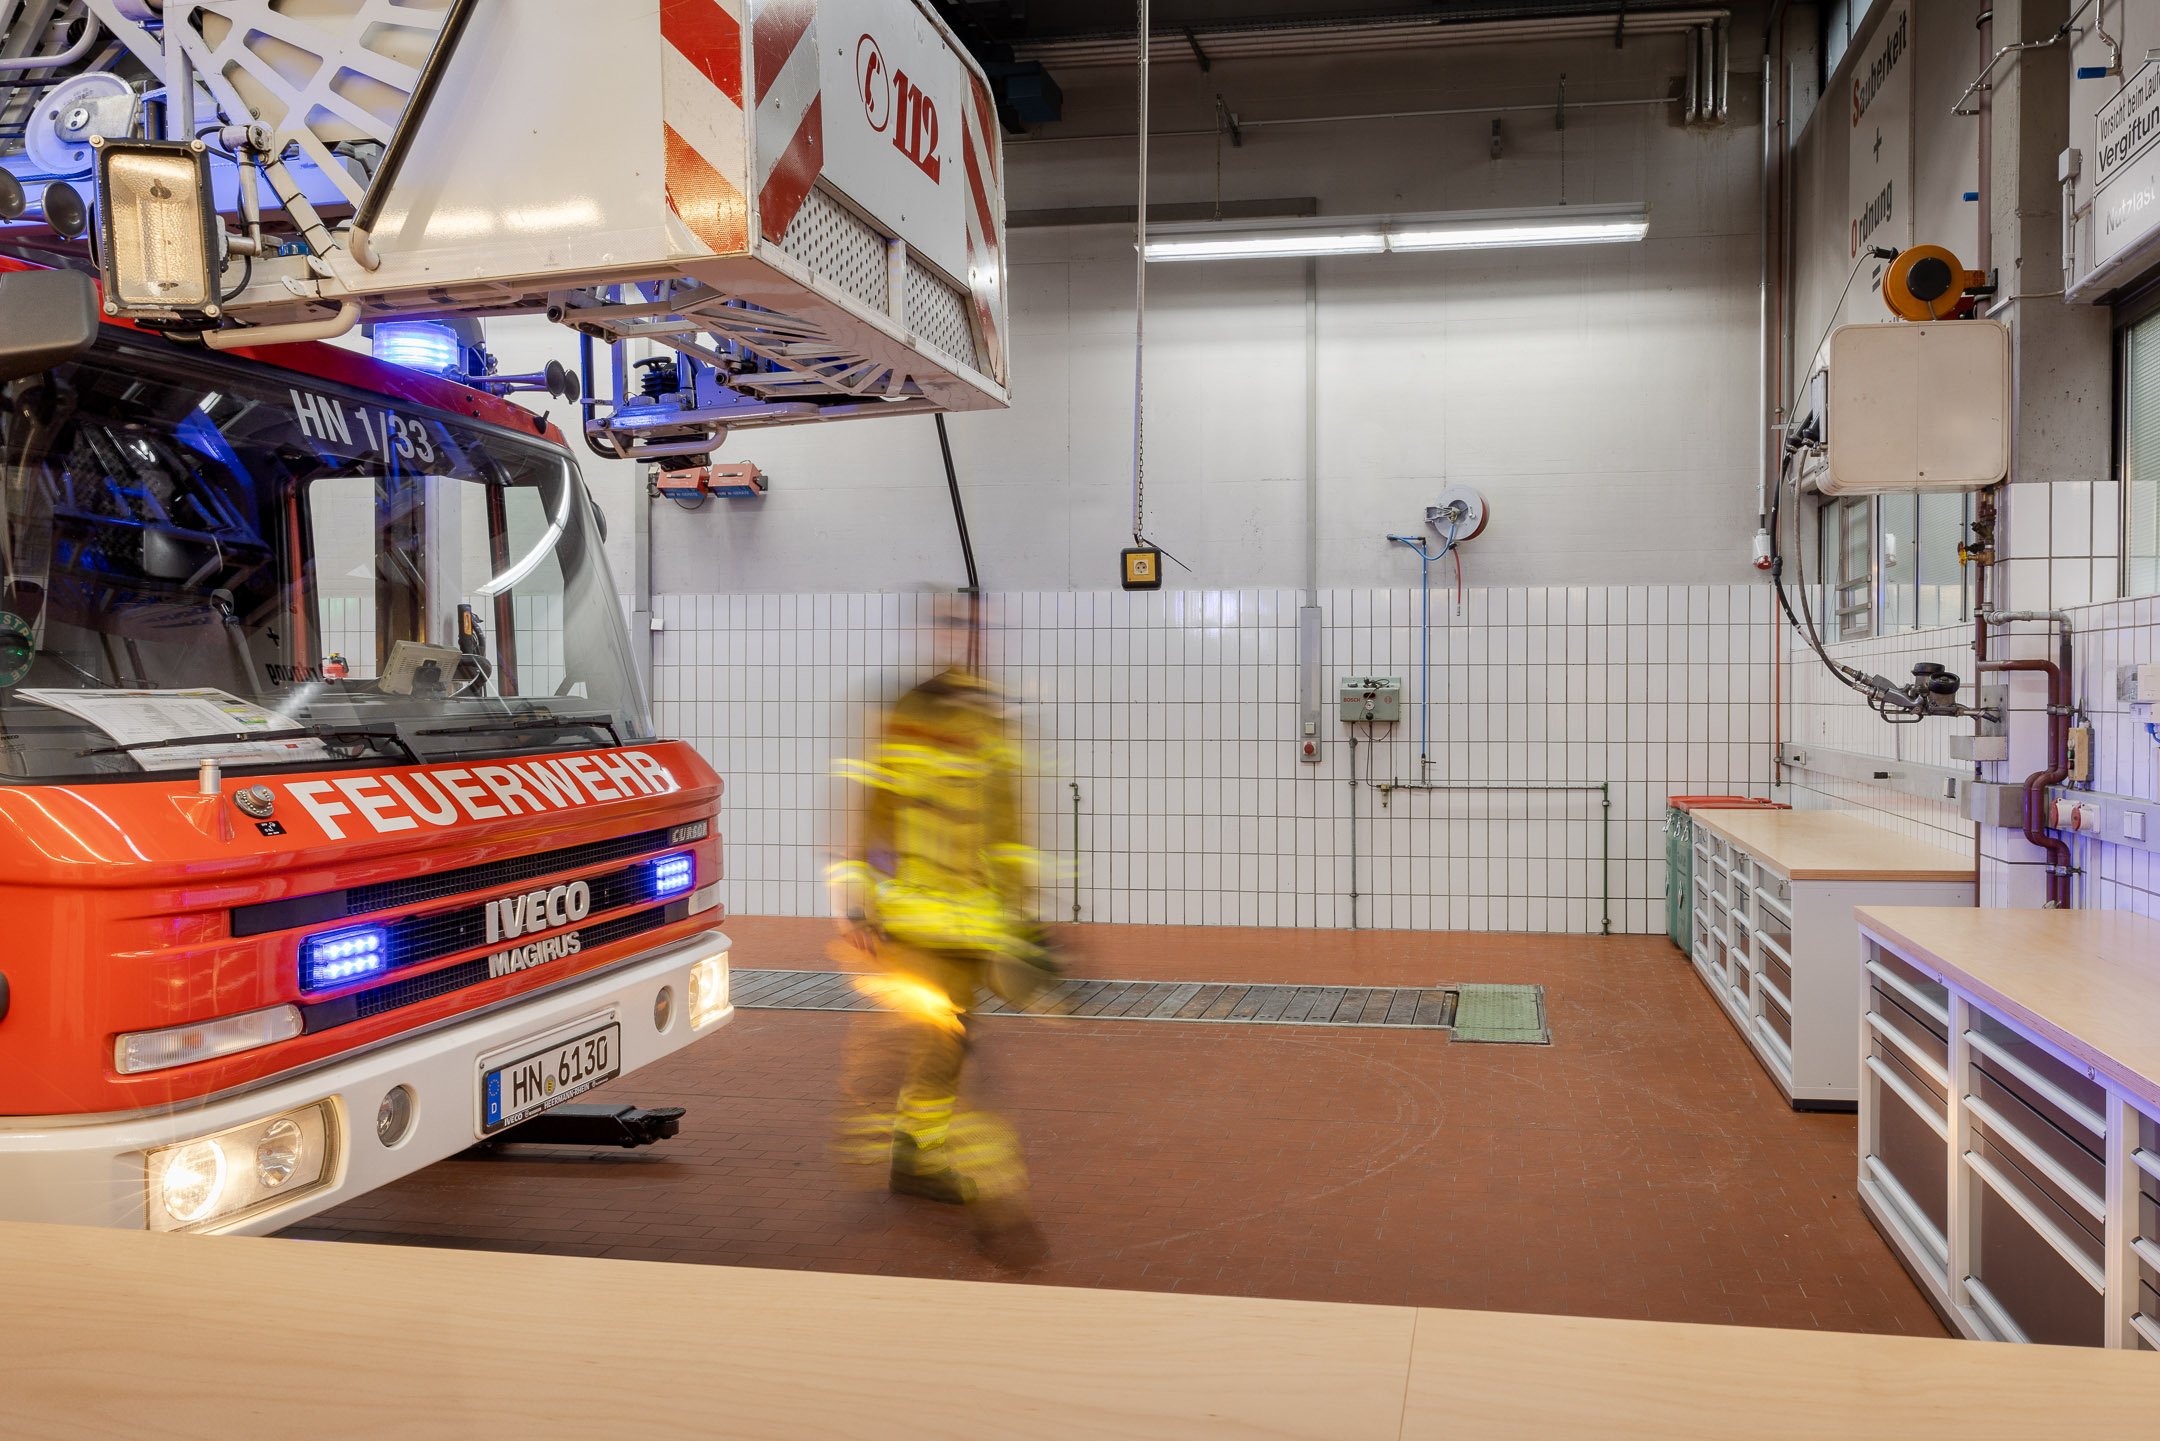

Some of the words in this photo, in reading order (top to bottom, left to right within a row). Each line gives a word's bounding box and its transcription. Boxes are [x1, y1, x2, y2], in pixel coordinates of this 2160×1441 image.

[1853, 10, 1907, 128] Sauberkeit
[2100, 98, 2126, 142] Vorsicht
[2127, 85, 2144, 118] beim
[2145, 64, 2160, 102] Lauf
[893, 68, 941, 186] 112
[1851, 179, 1893, 258] Ordnung
[289, 388, 353, 446] HN
[354, 406, 435, 463] 1/33
[283, 751, 681, 840] FEUERWEHR
[485, 881, 591, 944] IVECO
[488, 931, 581, 979] MAGIRUS
[491, 1102, 498, 1114] D
[513, 1060, 543, 1108] HN
[558, 1035, 608, 1086] 6130
[504, 1111, 523, 1127] IVECO
